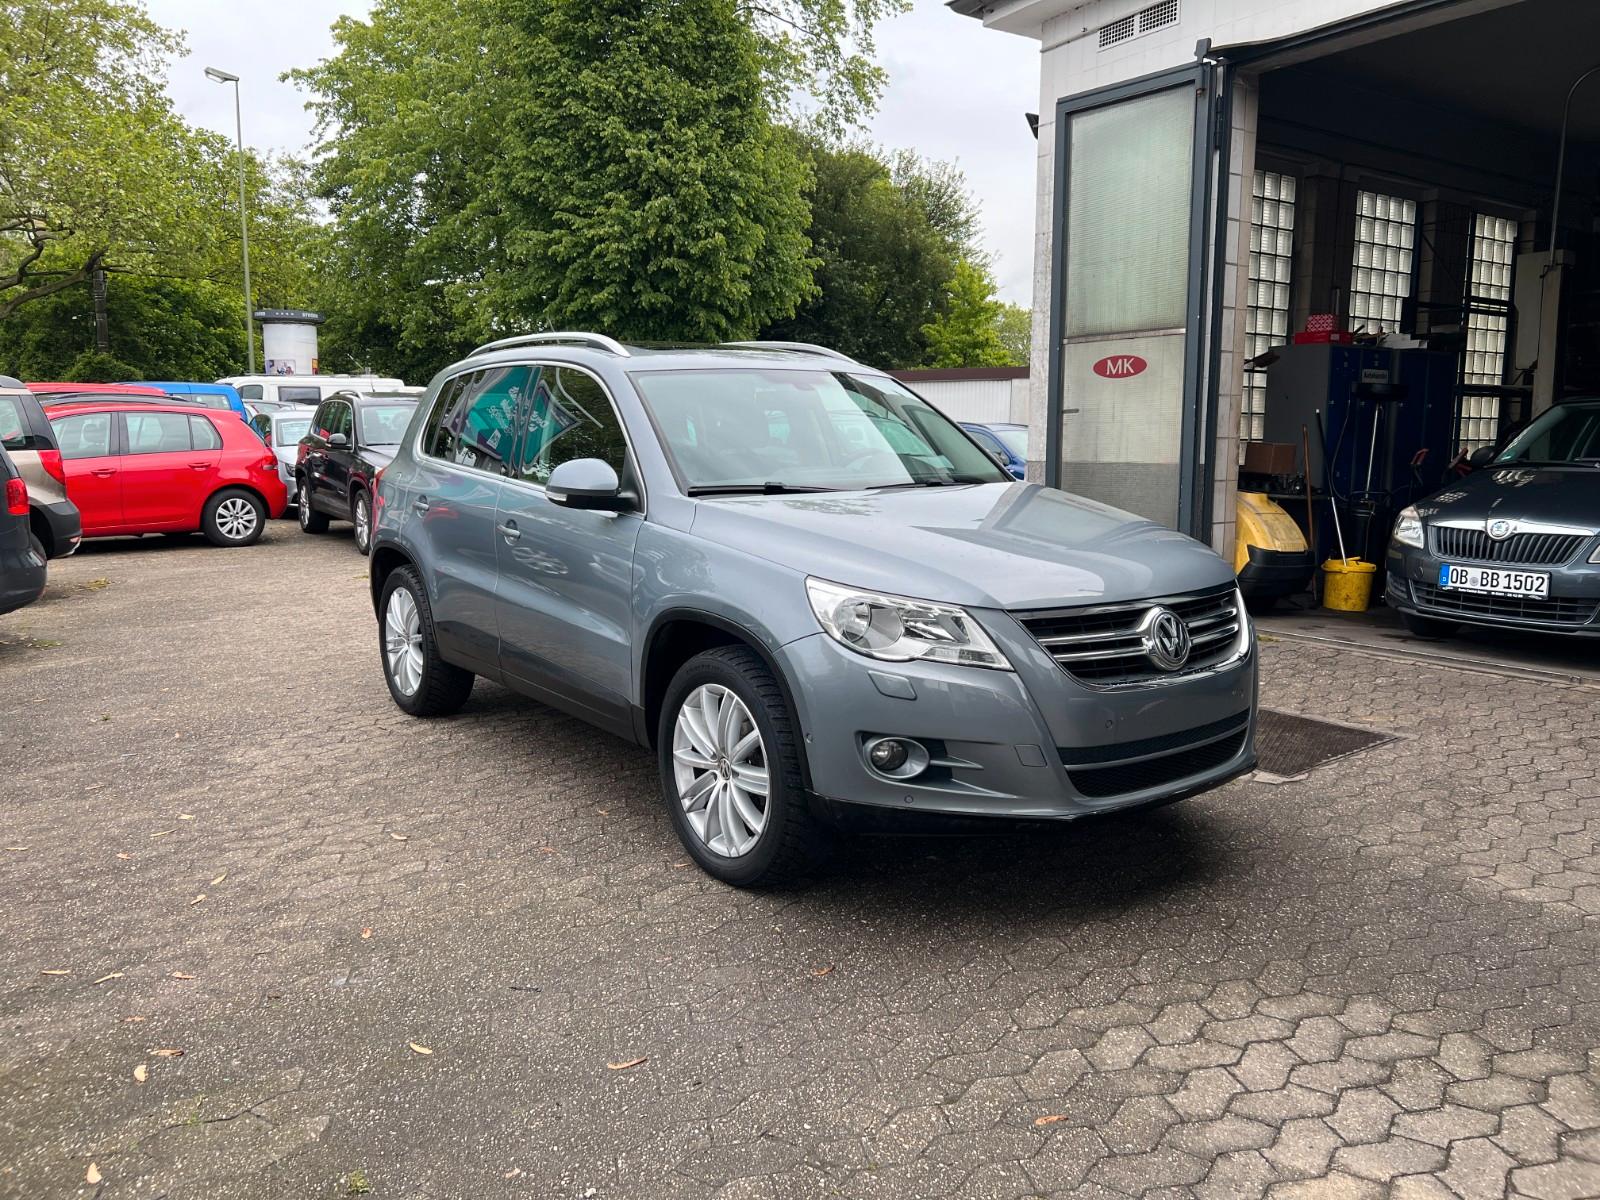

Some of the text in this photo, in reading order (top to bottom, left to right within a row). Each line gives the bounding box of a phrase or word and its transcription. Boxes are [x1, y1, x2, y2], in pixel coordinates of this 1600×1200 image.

[1106, 357, 1135, 375] MK
[1450, 568, 1468, 585] OB
[1480, 571, 1500, 588] BB
[1503, 573, 1545, 593] 1502
